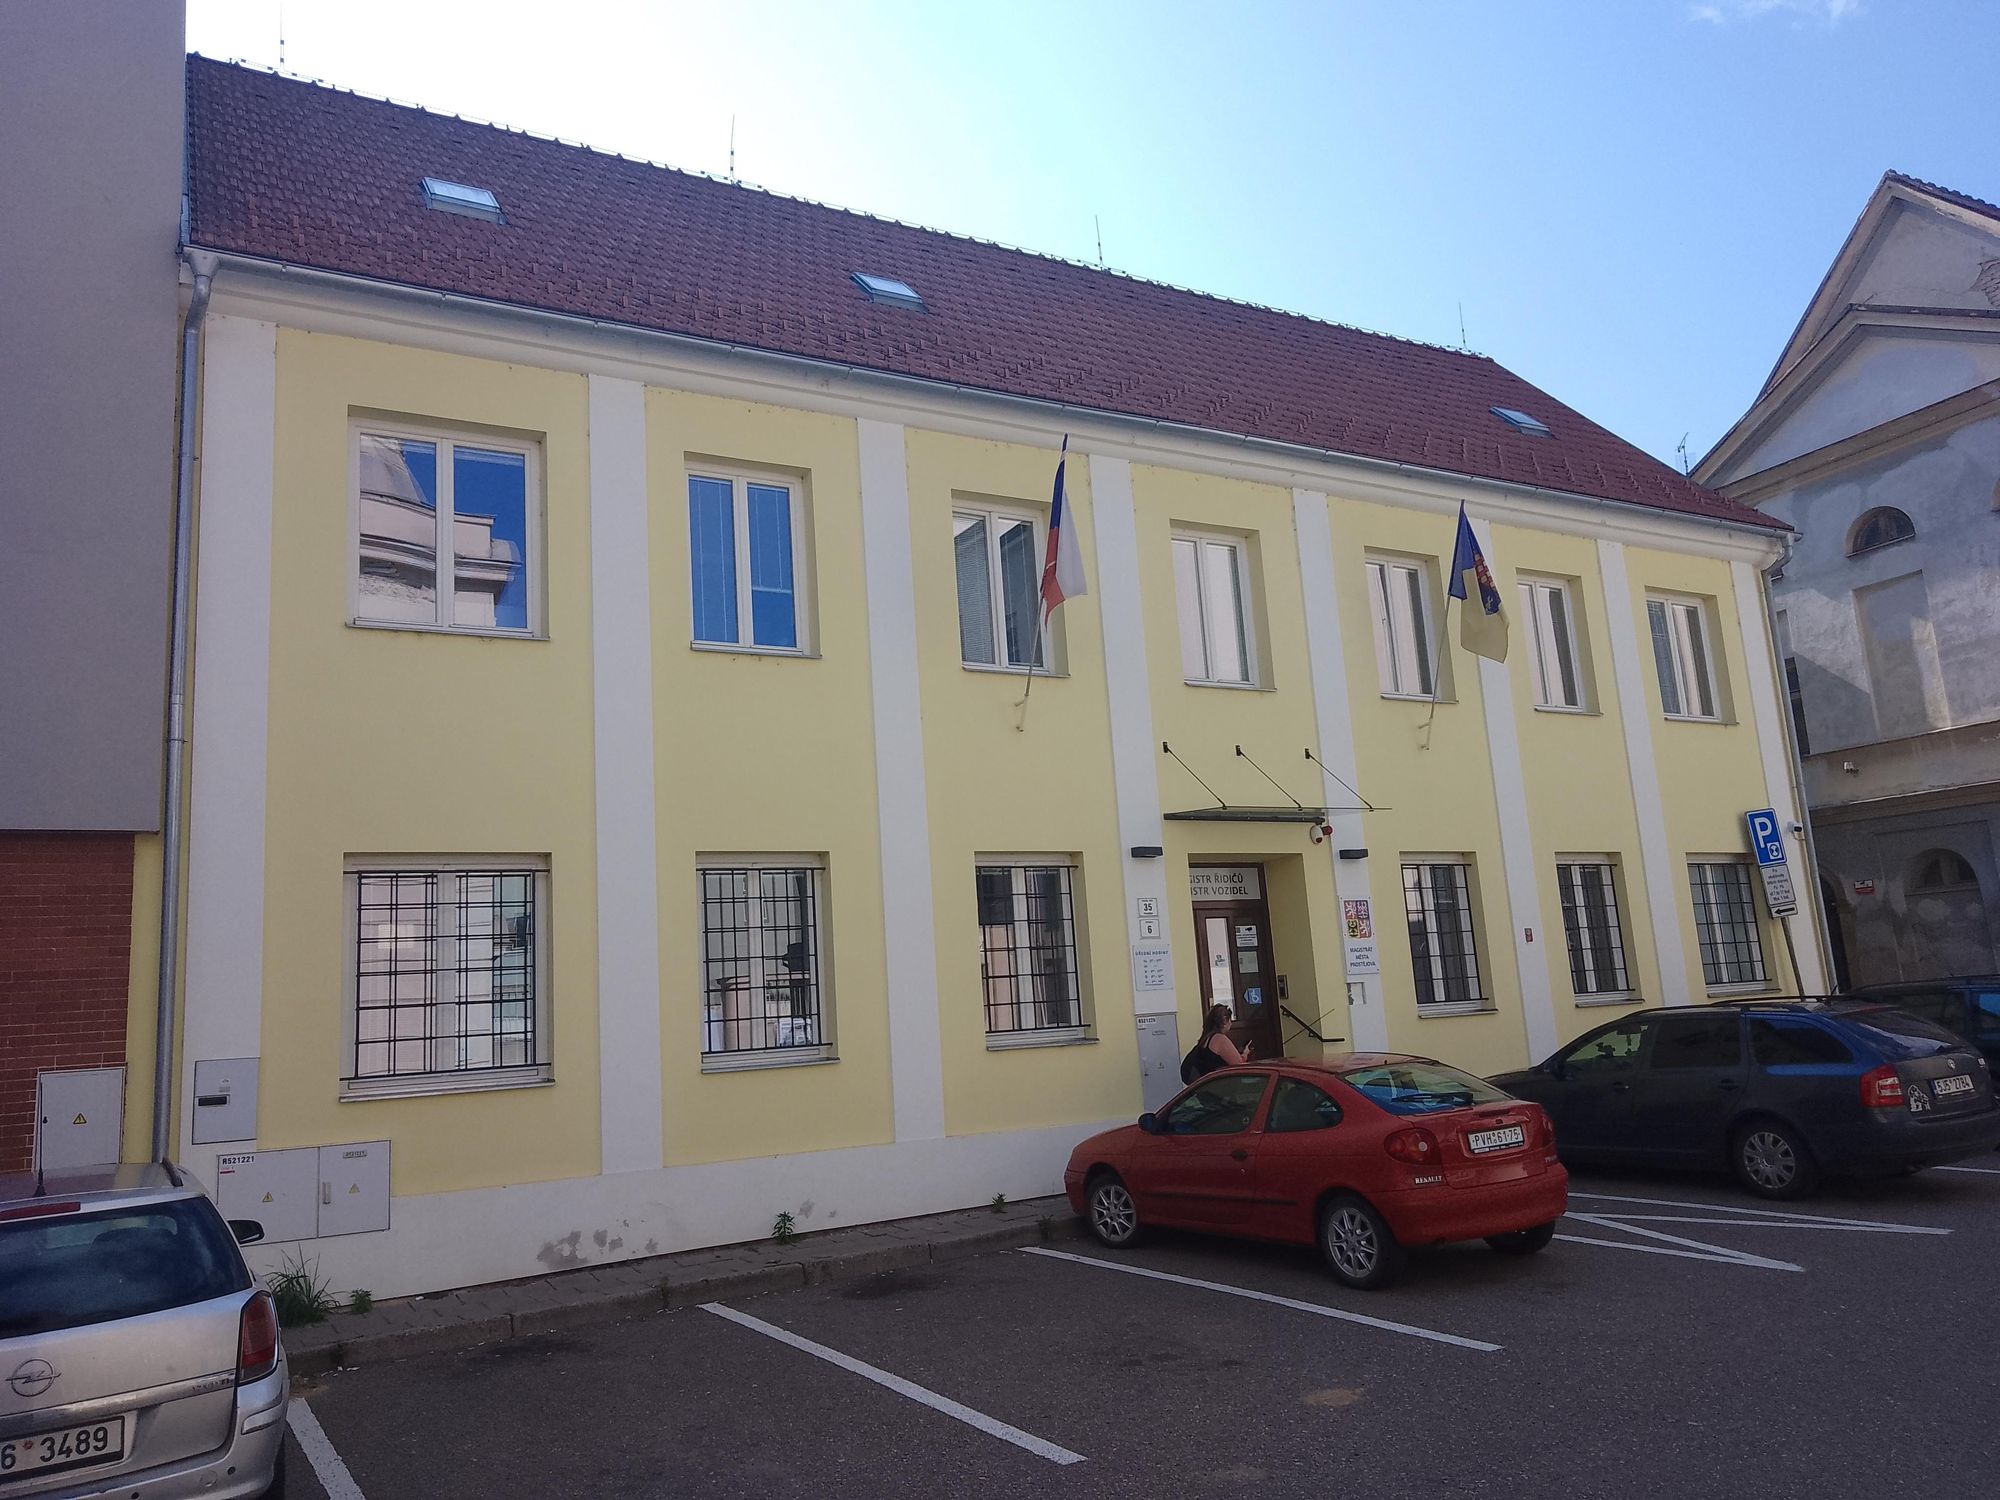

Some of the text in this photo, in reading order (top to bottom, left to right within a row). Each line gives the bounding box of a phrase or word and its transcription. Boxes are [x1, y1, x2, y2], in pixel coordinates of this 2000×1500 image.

[1754, 817, 1772, 848] P
[1214, 872, 1243, 884] ŘIDIČŮ
[1211, 886, 1248, 895] VOZIDEL
[1143, 903, 1153, 911] 35
[1147, 925, 1153, 934] 6
[1474, 1132, 1492, 1147] PVH
[1415, 1176, 1442, 1184] RENAULT
[39, 1426, 108, 1462] 3489
